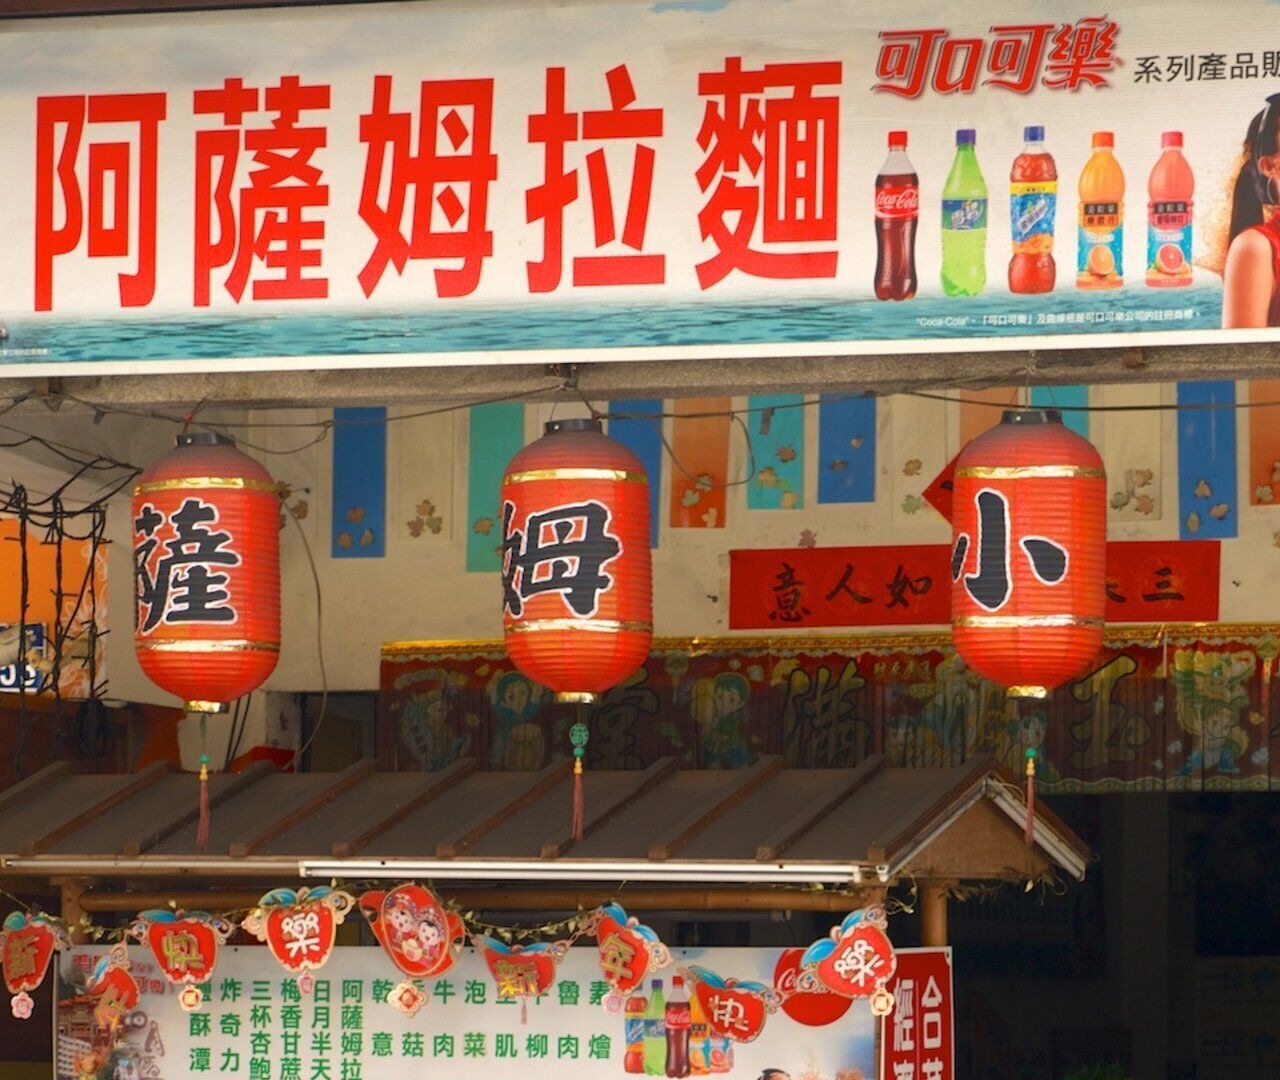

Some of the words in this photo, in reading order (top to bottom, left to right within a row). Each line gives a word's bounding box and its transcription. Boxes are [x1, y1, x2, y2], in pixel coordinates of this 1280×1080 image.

[870, 16, 1124, 99] 可口可樂
[34, 56, 843, 312] 阿薩姆拉麵
[134, 496, 243, 637] 薩
[501, 498, 623, 620] 姆
[952, 488, 1068, 612] 小
[281, 915, 321, 959] 樂
